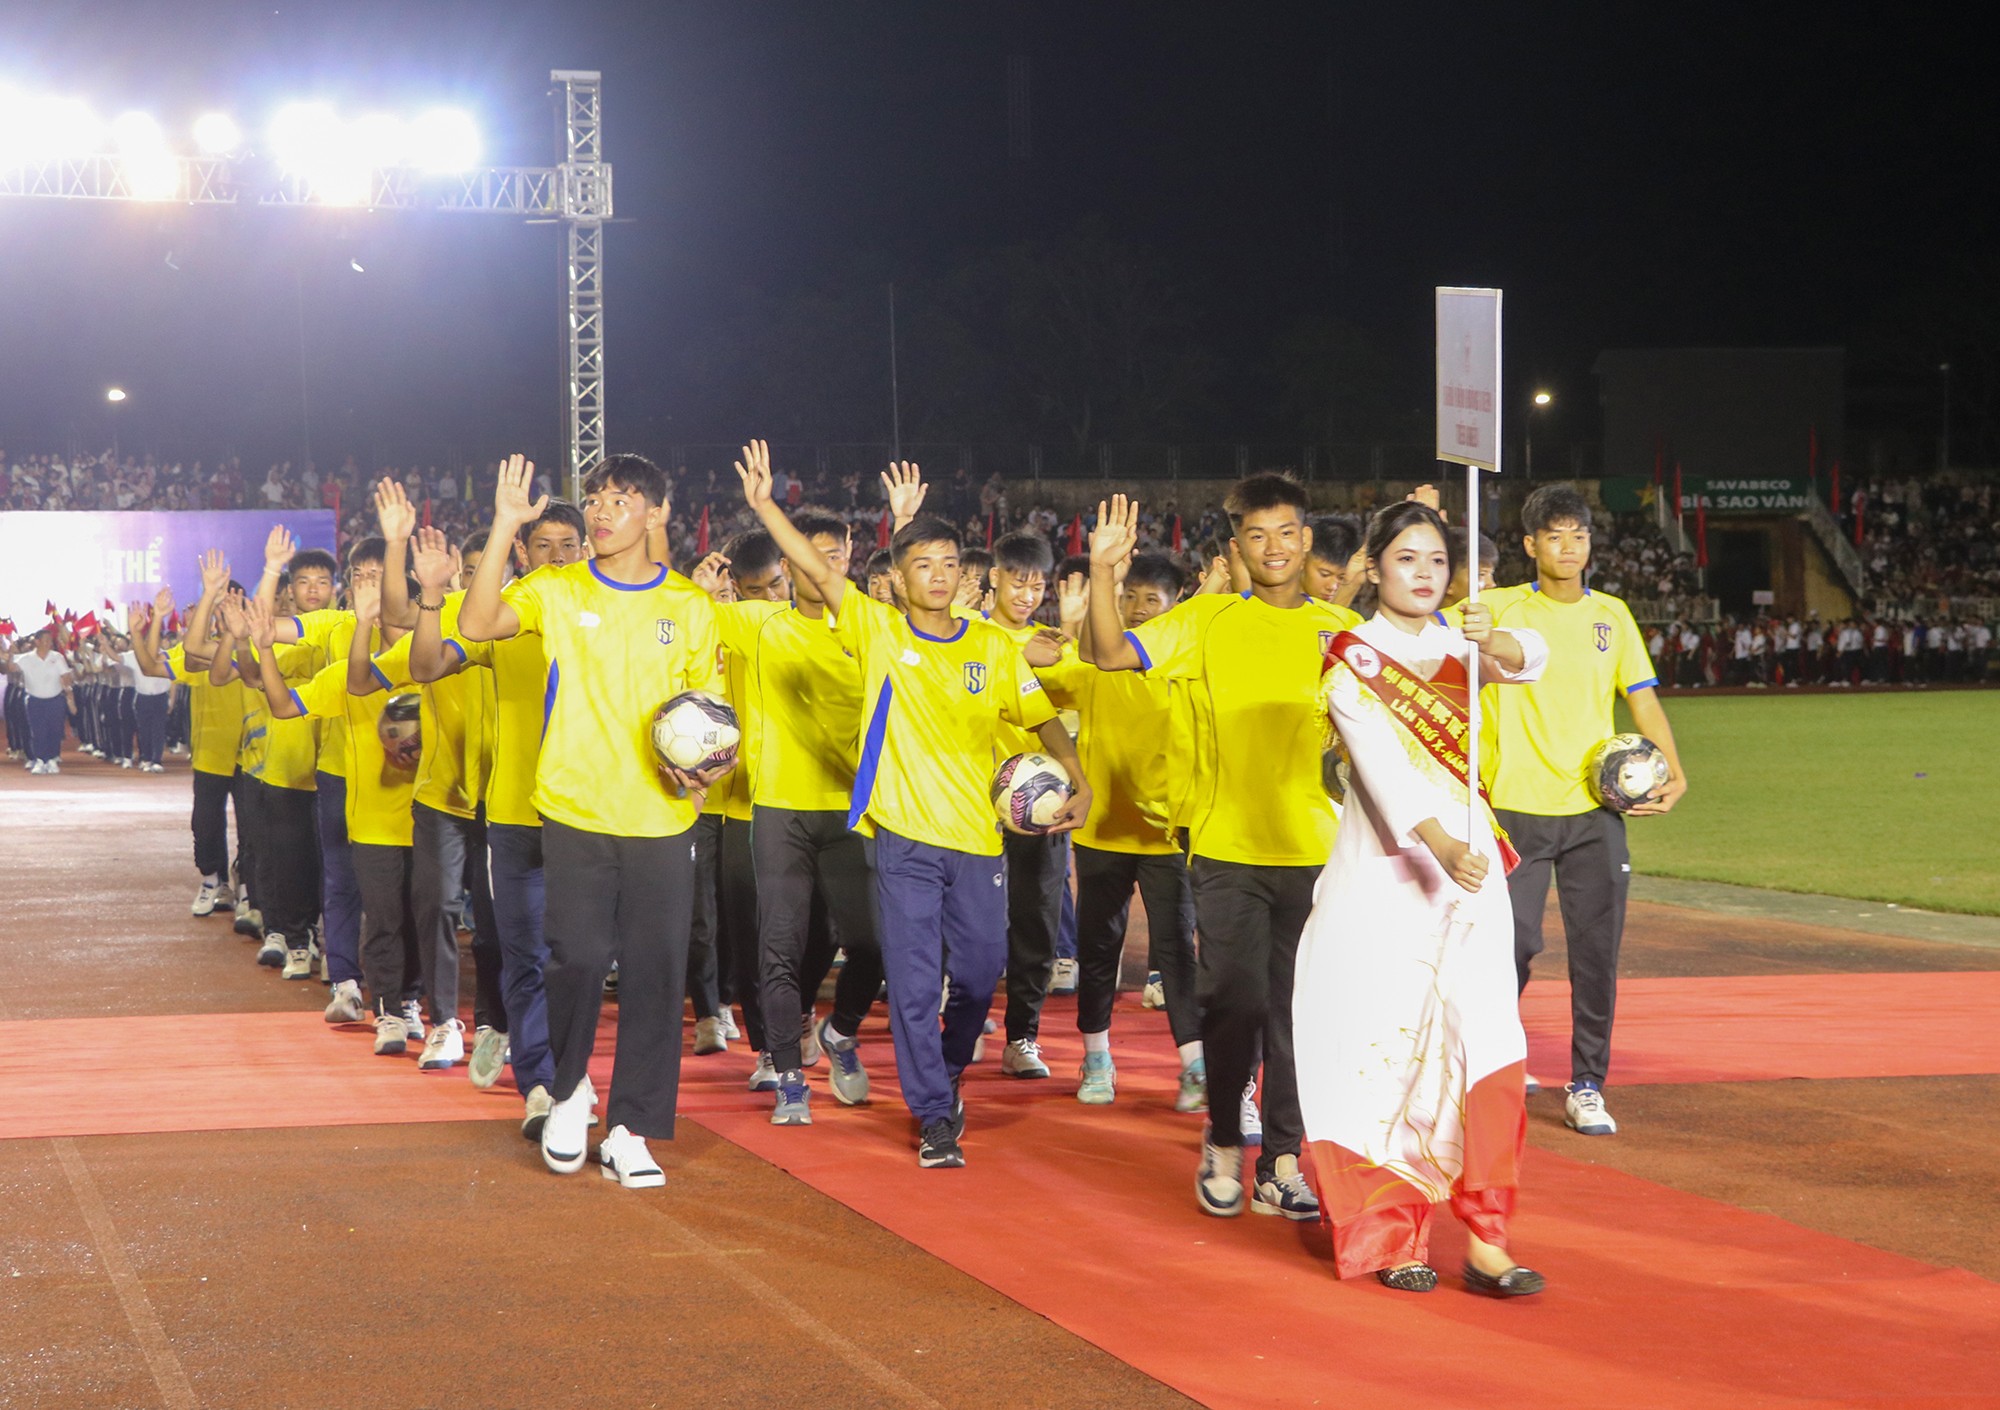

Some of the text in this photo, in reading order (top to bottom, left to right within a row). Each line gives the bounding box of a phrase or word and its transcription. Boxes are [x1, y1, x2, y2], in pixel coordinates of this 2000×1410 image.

[1706, 480, 1791, 490] SAVABECO
[1717, 495, 1758, 508] SAO
[109, 536, 163, 583] THỂ
[1390, 698, 1418, 722] LẦN
